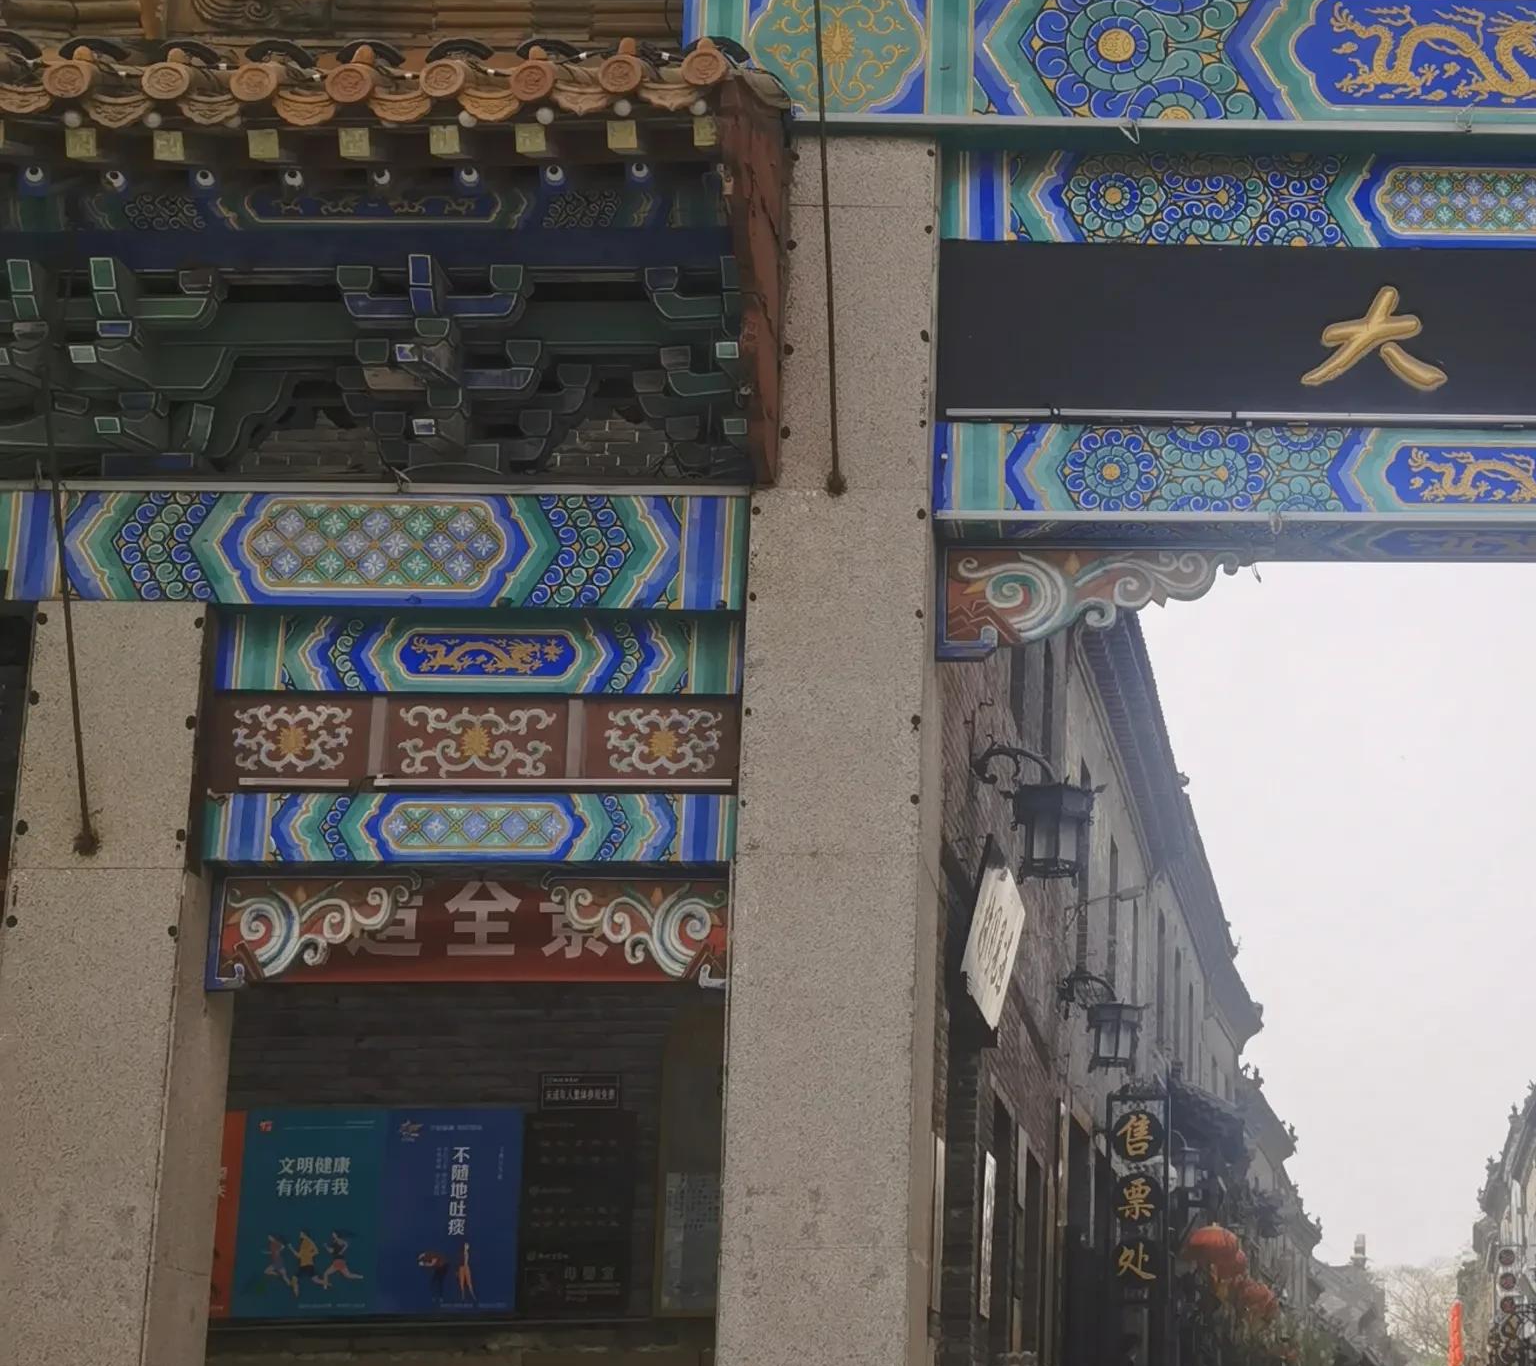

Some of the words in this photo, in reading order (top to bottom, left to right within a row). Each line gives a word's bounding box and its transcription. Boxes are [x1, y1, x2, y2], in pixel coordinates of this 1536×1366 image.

[275, 1178, 350, 1197] 有你有我
[277, 1156, 351, 1175] 文明健康
[447, 1146, 471, 1236] 不随地吐痰
[1115, 1114, 1157, 1281] 售票处
